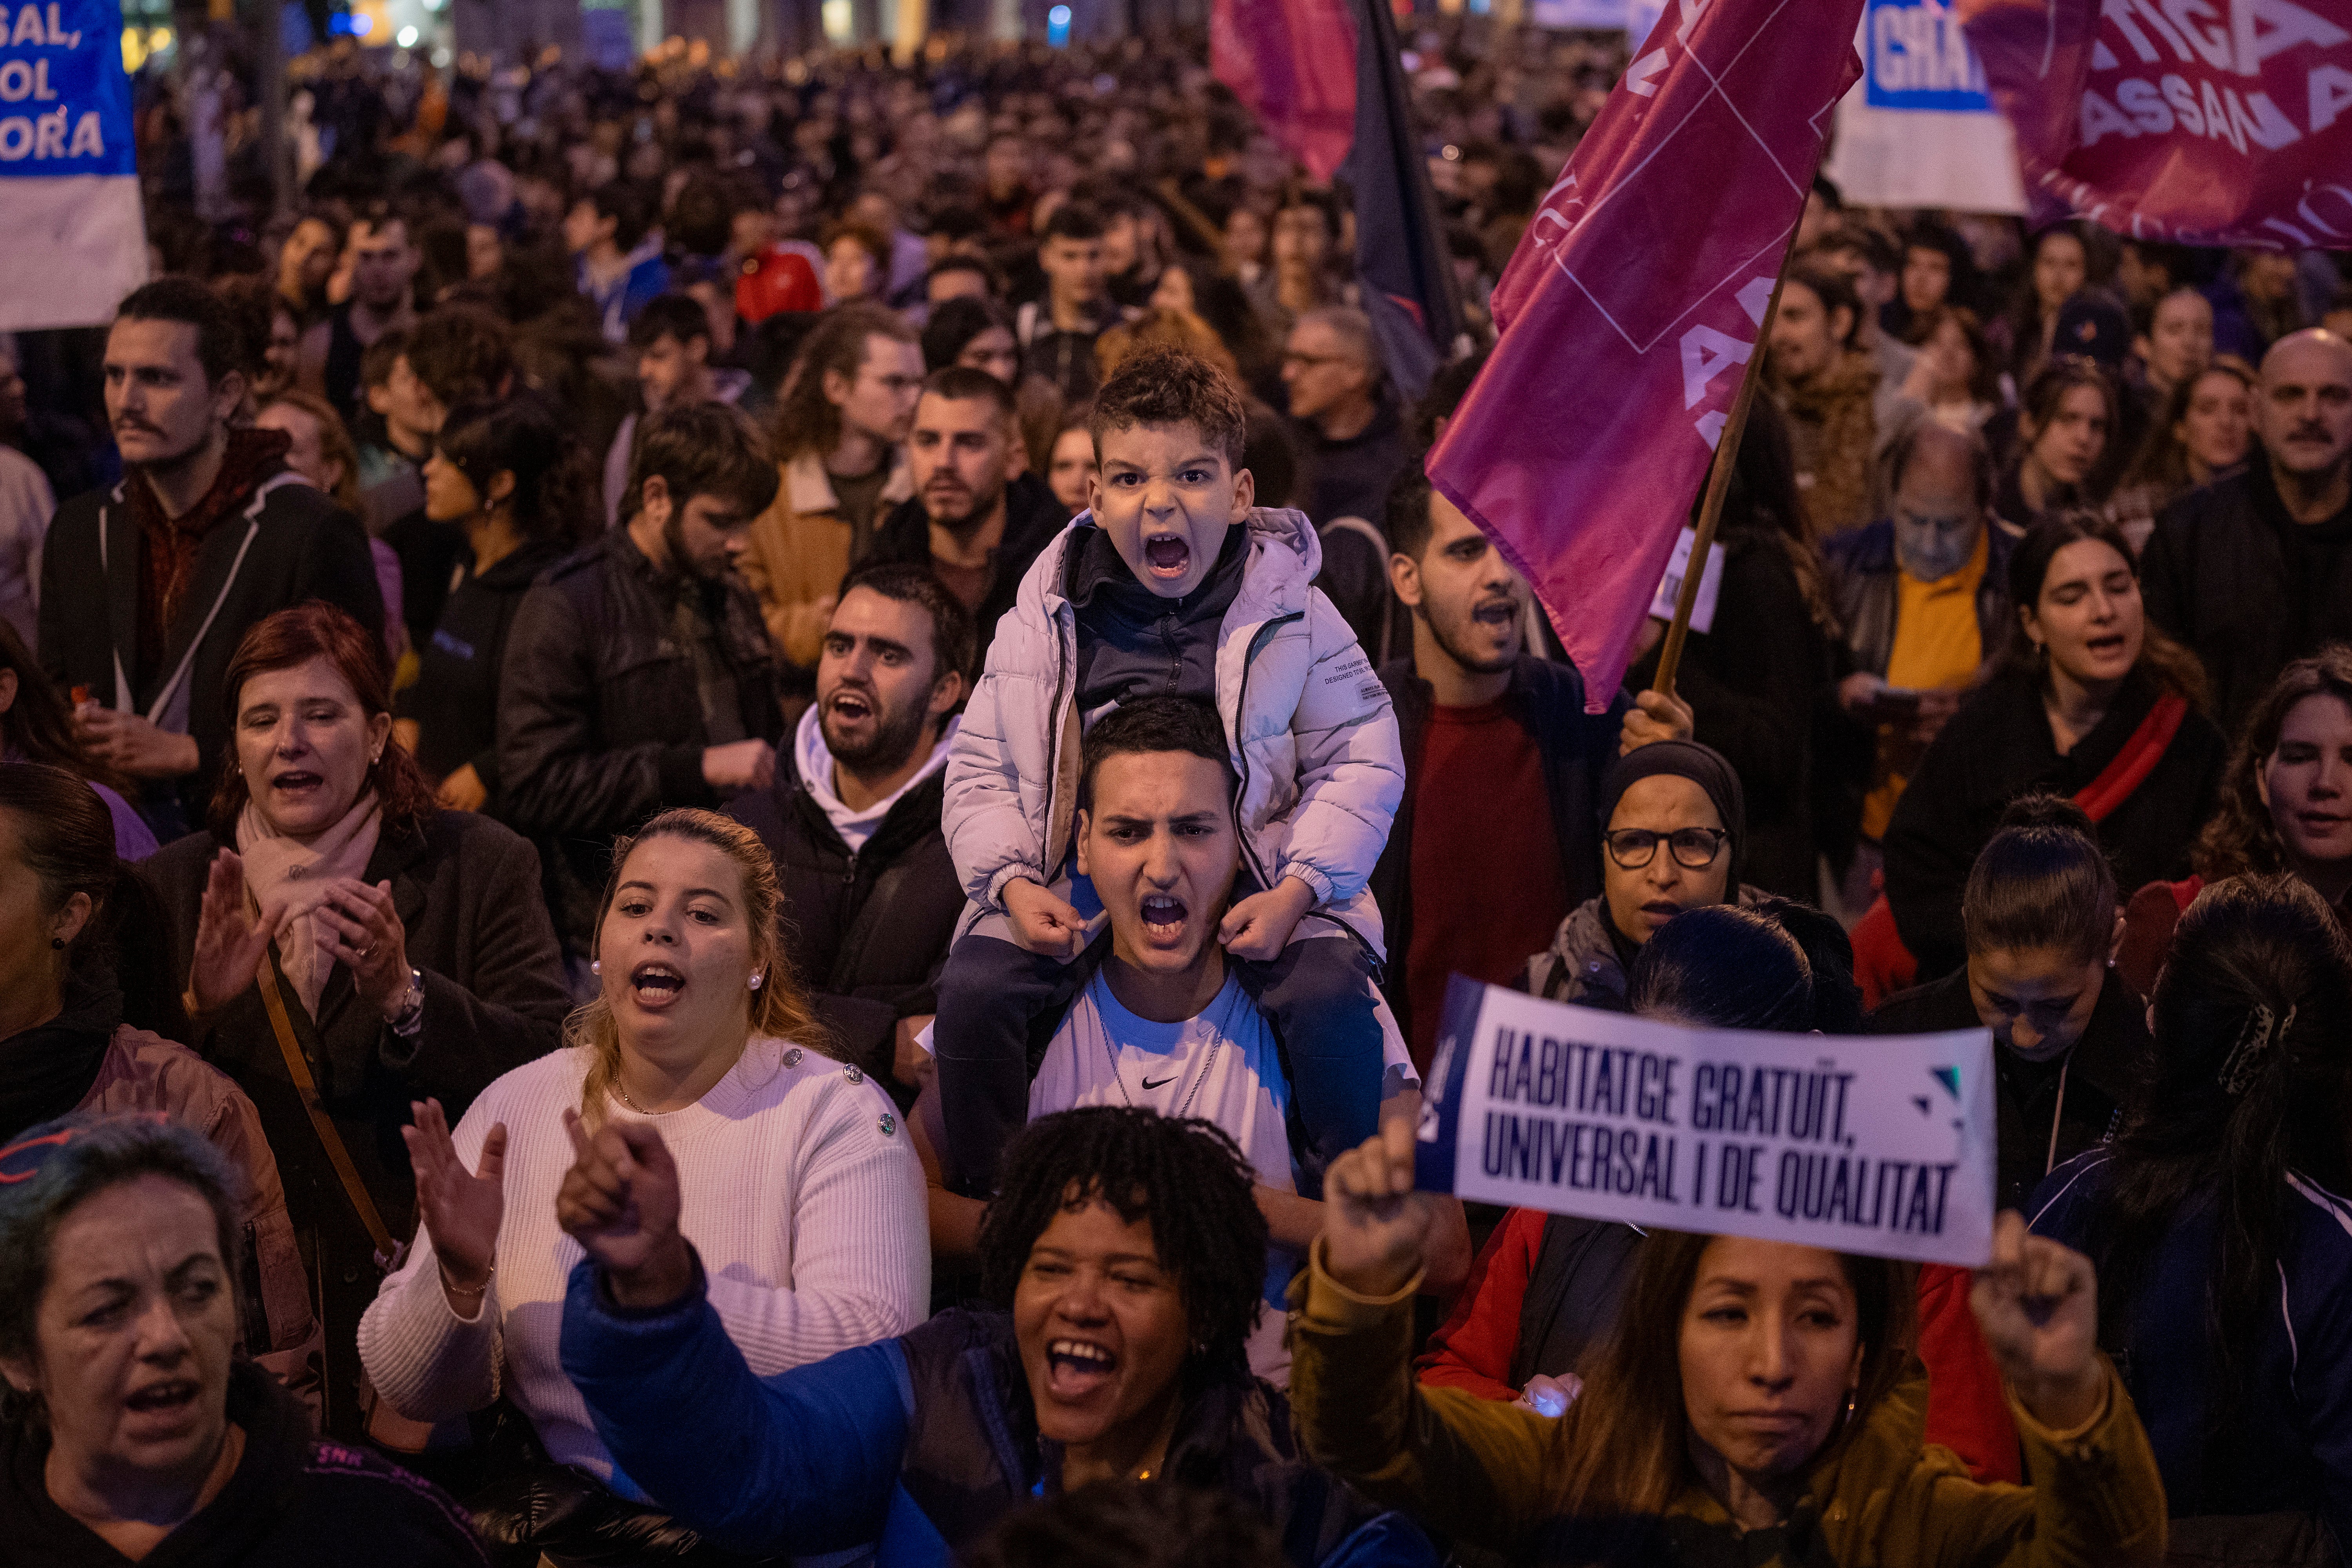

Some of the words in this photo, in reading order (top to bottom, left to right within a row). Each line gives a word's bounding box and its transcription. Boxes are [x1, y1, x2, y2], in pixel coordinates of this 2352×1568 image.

[1325, 671, 1353, 684] DESIGNED
[1335, 664, 1347, 672] THIS
[1488, 1025, 1680, 1125] HABITATGE
[1692, 1057, 1857, 1149] GRATUÏT,
[1482, 1109, 1679, 1205] UNIVERSAL
[1693, 1140, 1707, 1207] I
[1719, 1142, 1766, 1214] DE
[1776, 1148, 1958, 1236] QUALITAT
